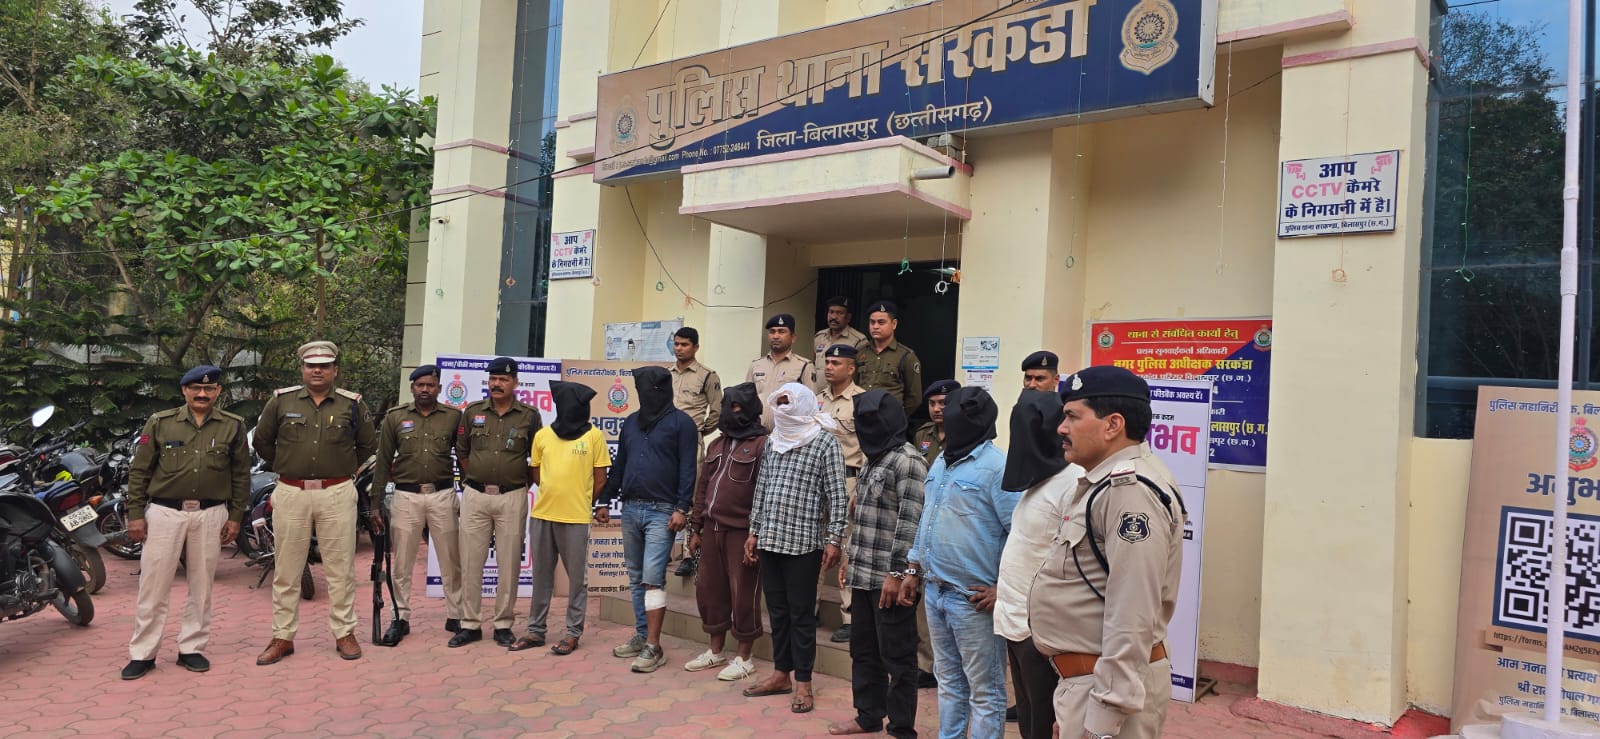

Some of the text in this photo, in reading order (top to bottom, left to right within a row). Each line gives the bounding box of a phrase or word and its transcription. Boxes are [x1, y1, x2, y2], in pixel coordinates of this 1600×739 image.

[646, 65, 765, 149] पुलिस
[775, 40, 889, 107] थाना
[757, 96, 992, 149] जिला-बिलासपुर (छत्तीसगढ़)
[682, 150, 698, 159] Phone
[1319, 161, 1357, 178] आप
[1291, 177, 1382, 199] CCTV कैमरे
[1285, 203, 1298, 218] के
[1302, 199, 1357, 217] निगरानी
[1360, 198, 1372, 213] में
[564, 235, 578, 245] आप
[554, 248, 573, 256] CCTV
[1128, 330, 1147, 338] थाना
[1151, 329, 1159, 338] से
[1224, 328, 1239, 339] हेतु
[1137, 357, 1166, 372] पुलिस
[1170, 356, 1212, 369] अधीक्षक
[1216, 357, 1253, 370] सरकंडा
[1176, 391, 1194, 399] अवश्य
[1489, 399, 1517, 412] पुलिस
[1497, 657, 1597, 683] आम जनत प्रत्यक्ष
[1518, 681, 1530, 693] श्री
[1499, 696, 1520, 706] पुलिस
